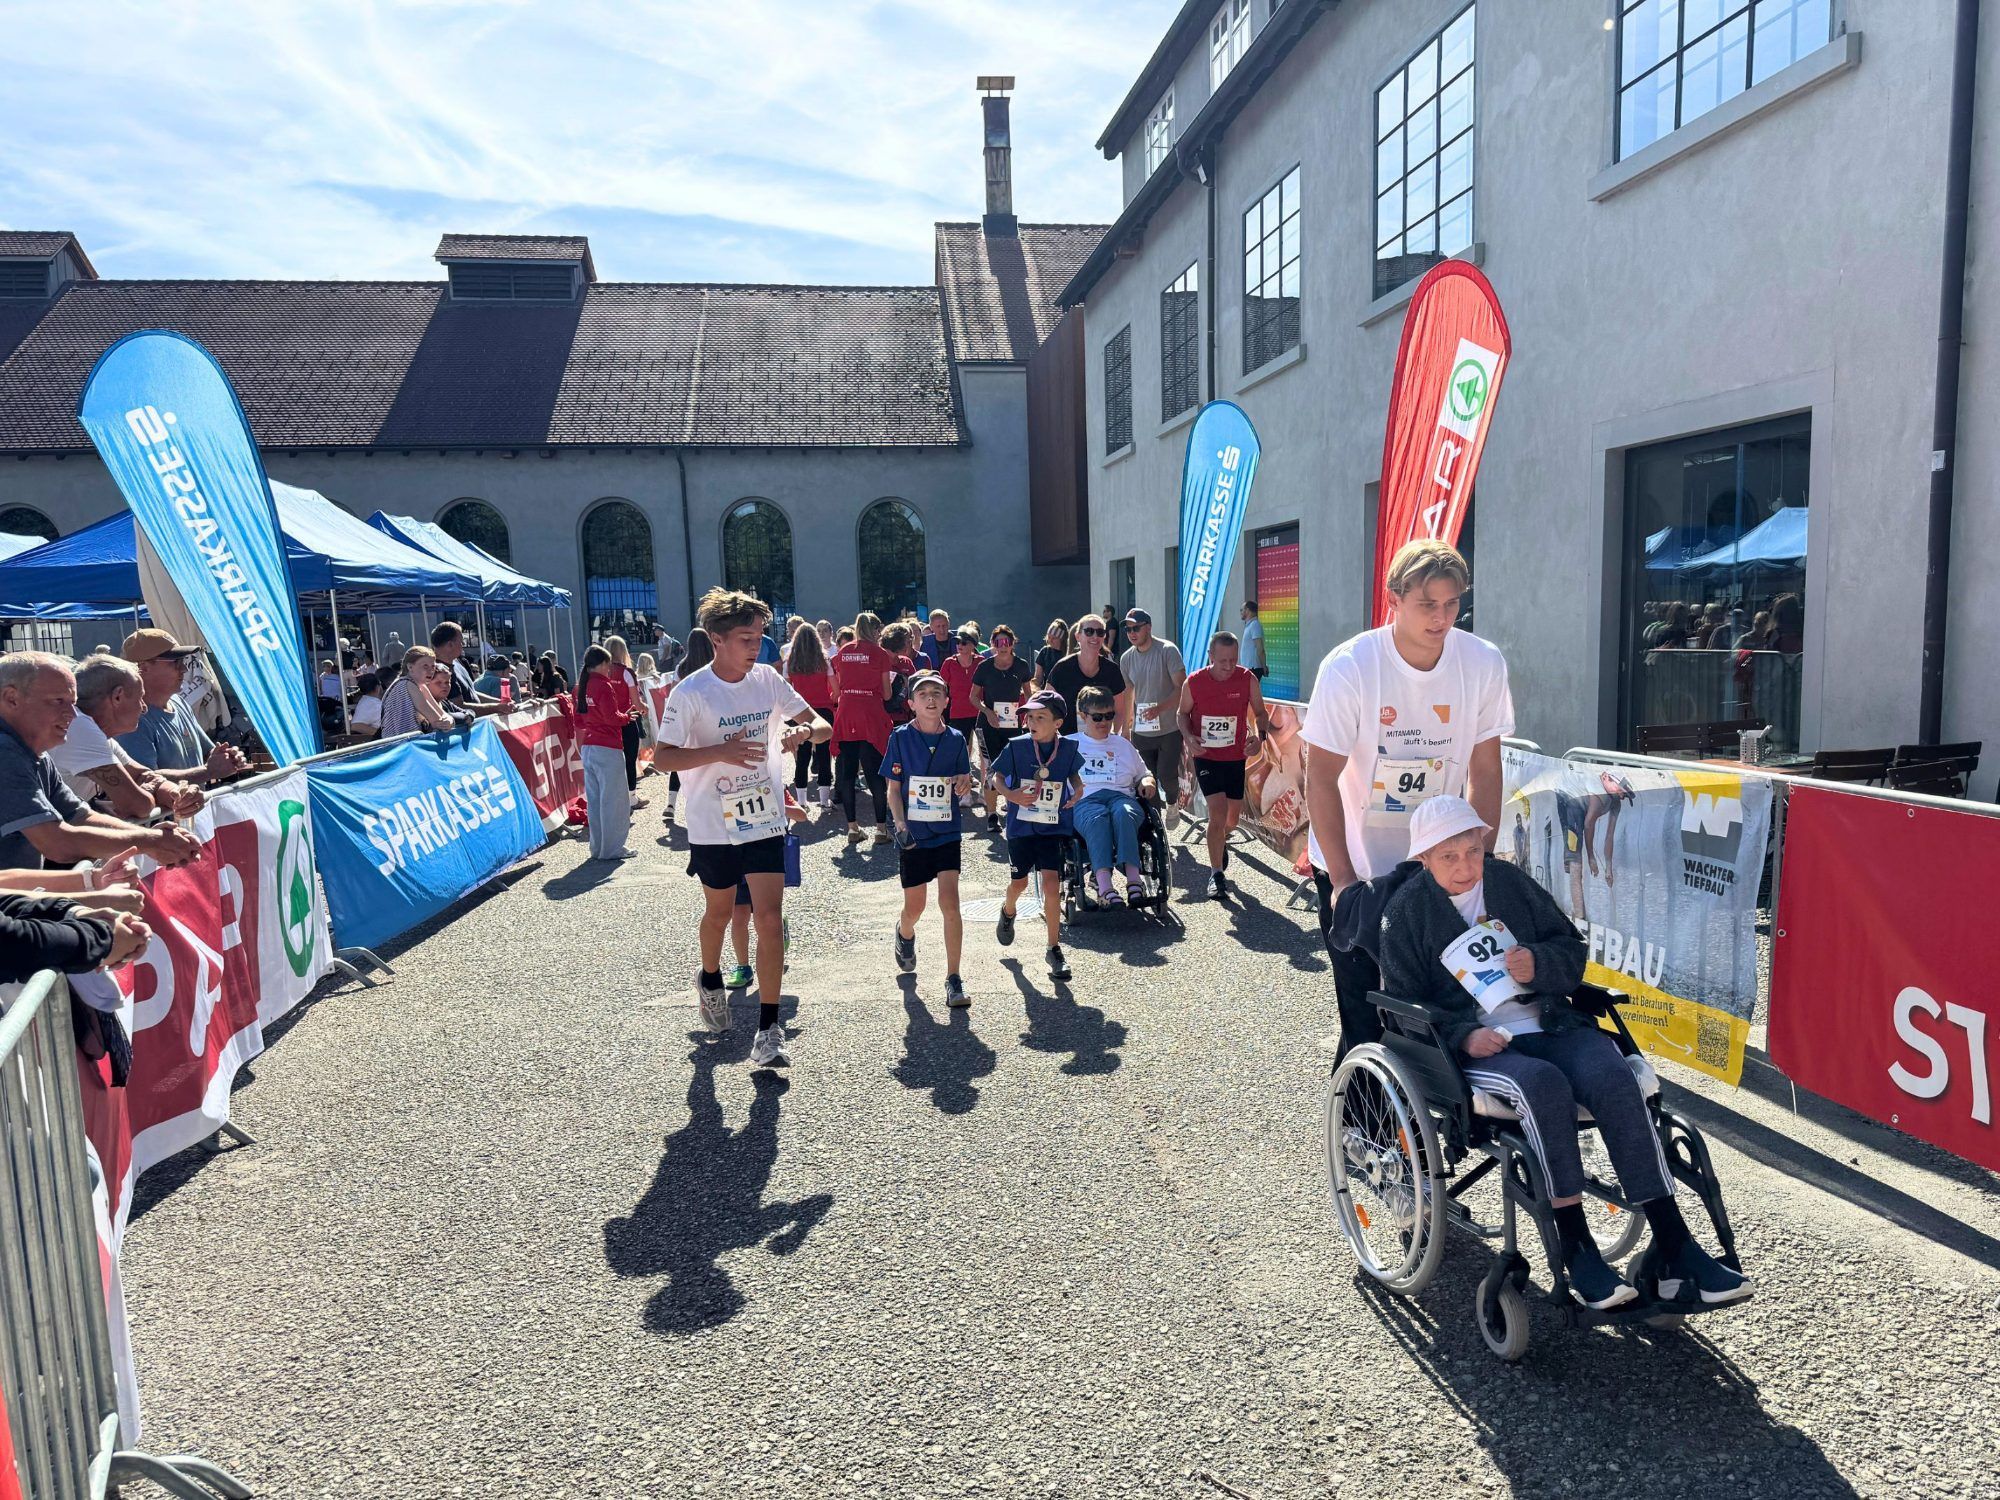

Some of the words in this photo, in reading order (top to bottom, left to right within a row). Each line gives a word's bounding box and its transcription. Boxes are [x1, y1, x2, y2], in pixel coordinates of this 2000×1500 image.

[1189, 471, 1235, 609] SPARKASSE
[1004, 706, 1010, 715] 5
[1208, 721, 1230, 732] 229
[1386, 729, 1421, 738] MITANAND
[532, 733, 585, 800] SPA
[1090, 759, 1105, 768] 14
[918, 784, 945, 798] 319
[1397, 772, 1426, 793] 94
[735, 795, 765, 817] 111
[363, 771, 502, 877] SPARKASSE
[1683, 858, 1735, 884] WACHTER
[1683, 872, 1725, 897] TIEFBAU
[1467, 935, 1505, 962] 92
[1640, 995, 1676, 1016] Beratung
[1618, 1009, 1669, 1028] vereinbaren!
[1888, 986, 2000, 1125] ST
